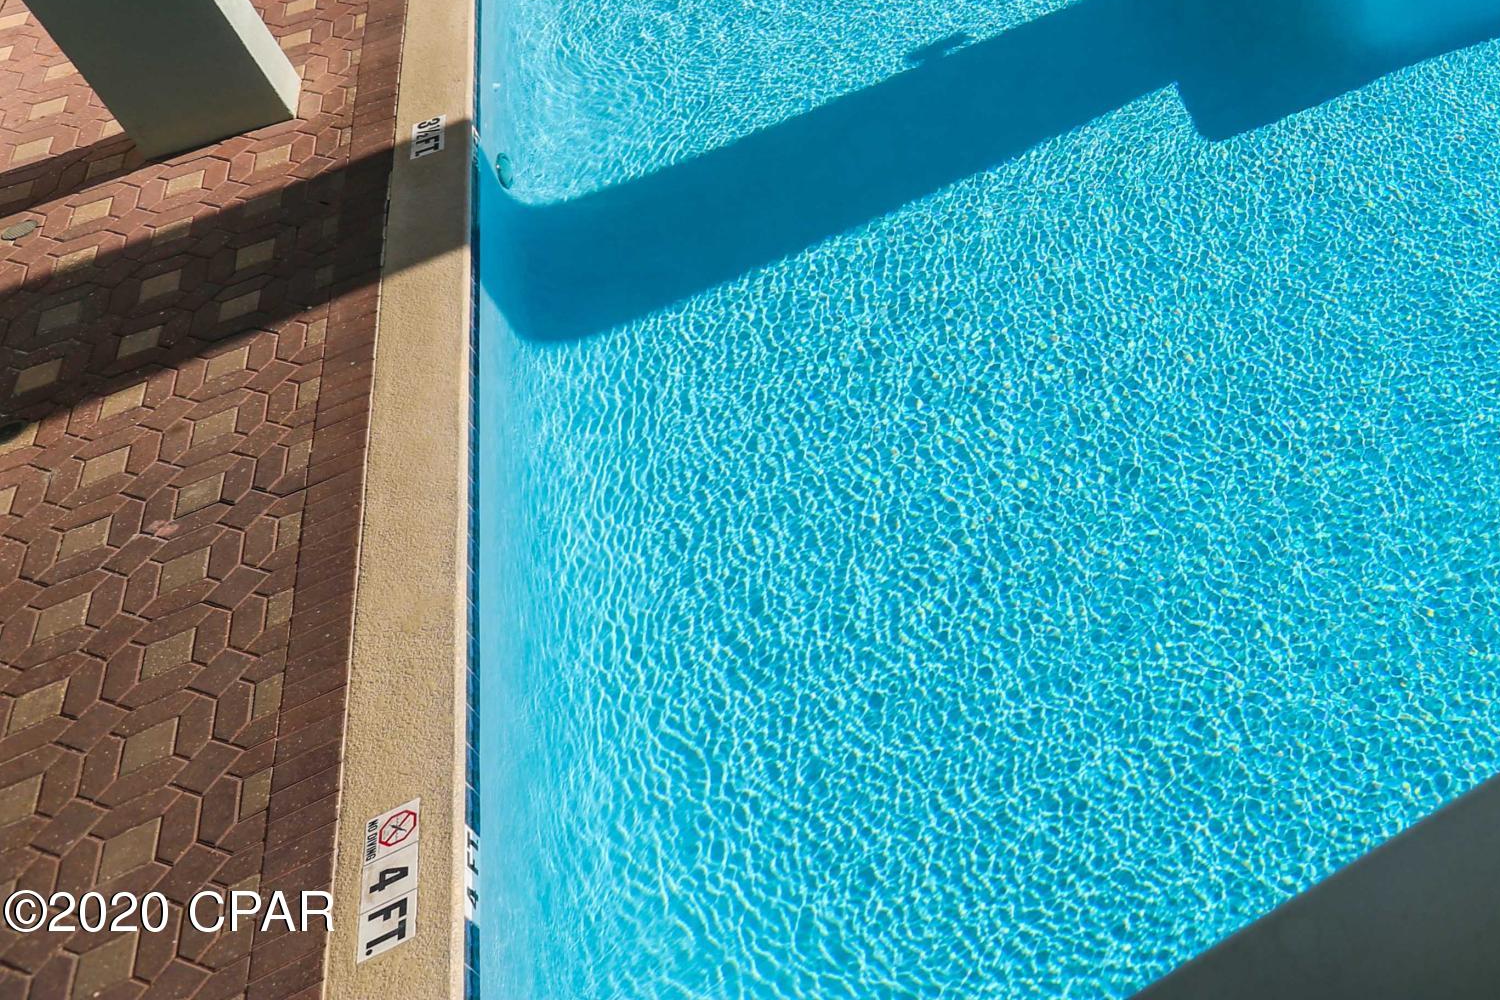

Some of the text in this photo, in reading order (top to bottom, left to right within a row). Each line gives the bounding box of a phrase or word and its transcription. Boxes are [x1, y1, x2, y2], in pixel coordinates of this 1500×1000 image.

[365, 818, 379, 862] NO DIVING
[369, 866, 409, 894] 4
[467, 886, 479, 910] 4
